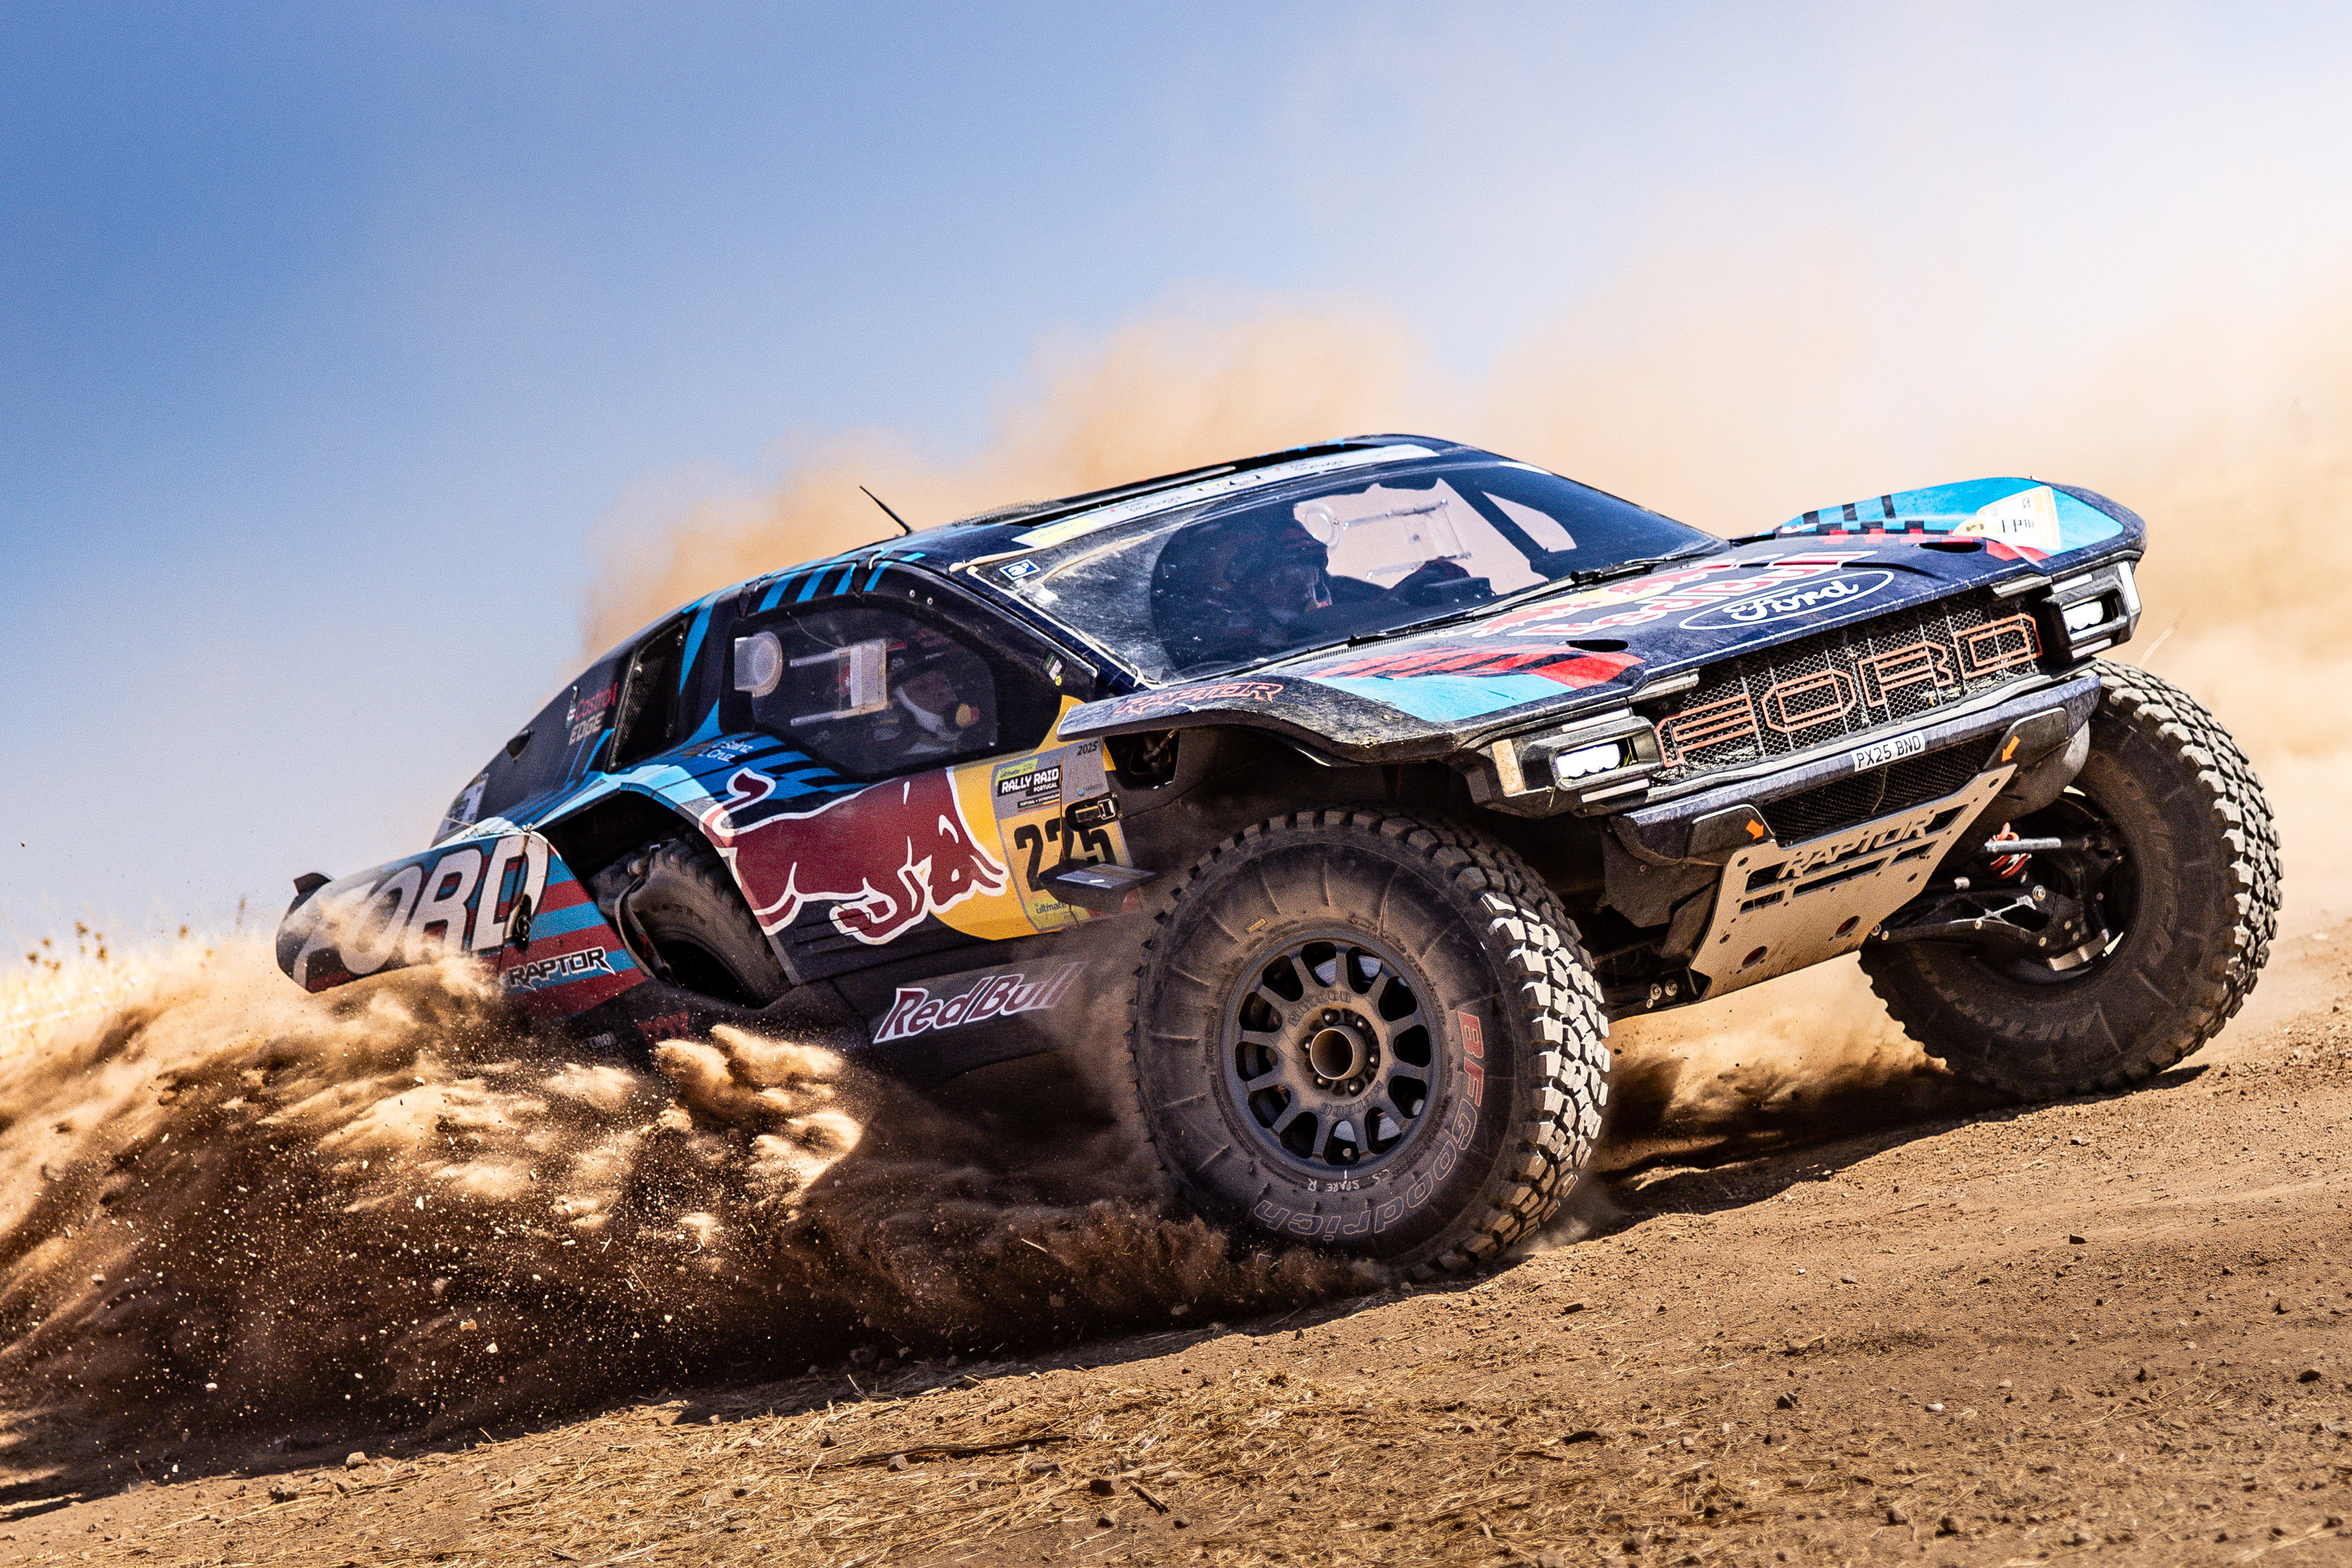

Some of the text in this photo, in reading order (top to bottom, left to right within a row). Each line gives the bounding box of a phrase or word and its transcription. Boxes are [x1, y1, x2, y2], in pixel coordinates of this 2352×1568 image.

[1722, 580, 1859, 621] Ford
[1113, 682, 1284, 716] RAPTOR
[1654, 613, 2044, 769] FORD
[1077, 740, 1099, 756] 2025
[1855, 744, 1892, 769] PX25
[1001, 768, 1060, 793] RALLY RAID
[1034, 782, 1058, 792] PORTUGAL
[1777, 810, 1936, 879] RAPTOR
[506, 946, 616, 992] RAPTOR
[873, 960, 1090, 1044] Red Bull
[1253, 1010, 1484, 1242] BFGoodrich
[1308, 1178, 1318, 1192] R
[1325, 1179, 1360, 1192] SPARE
